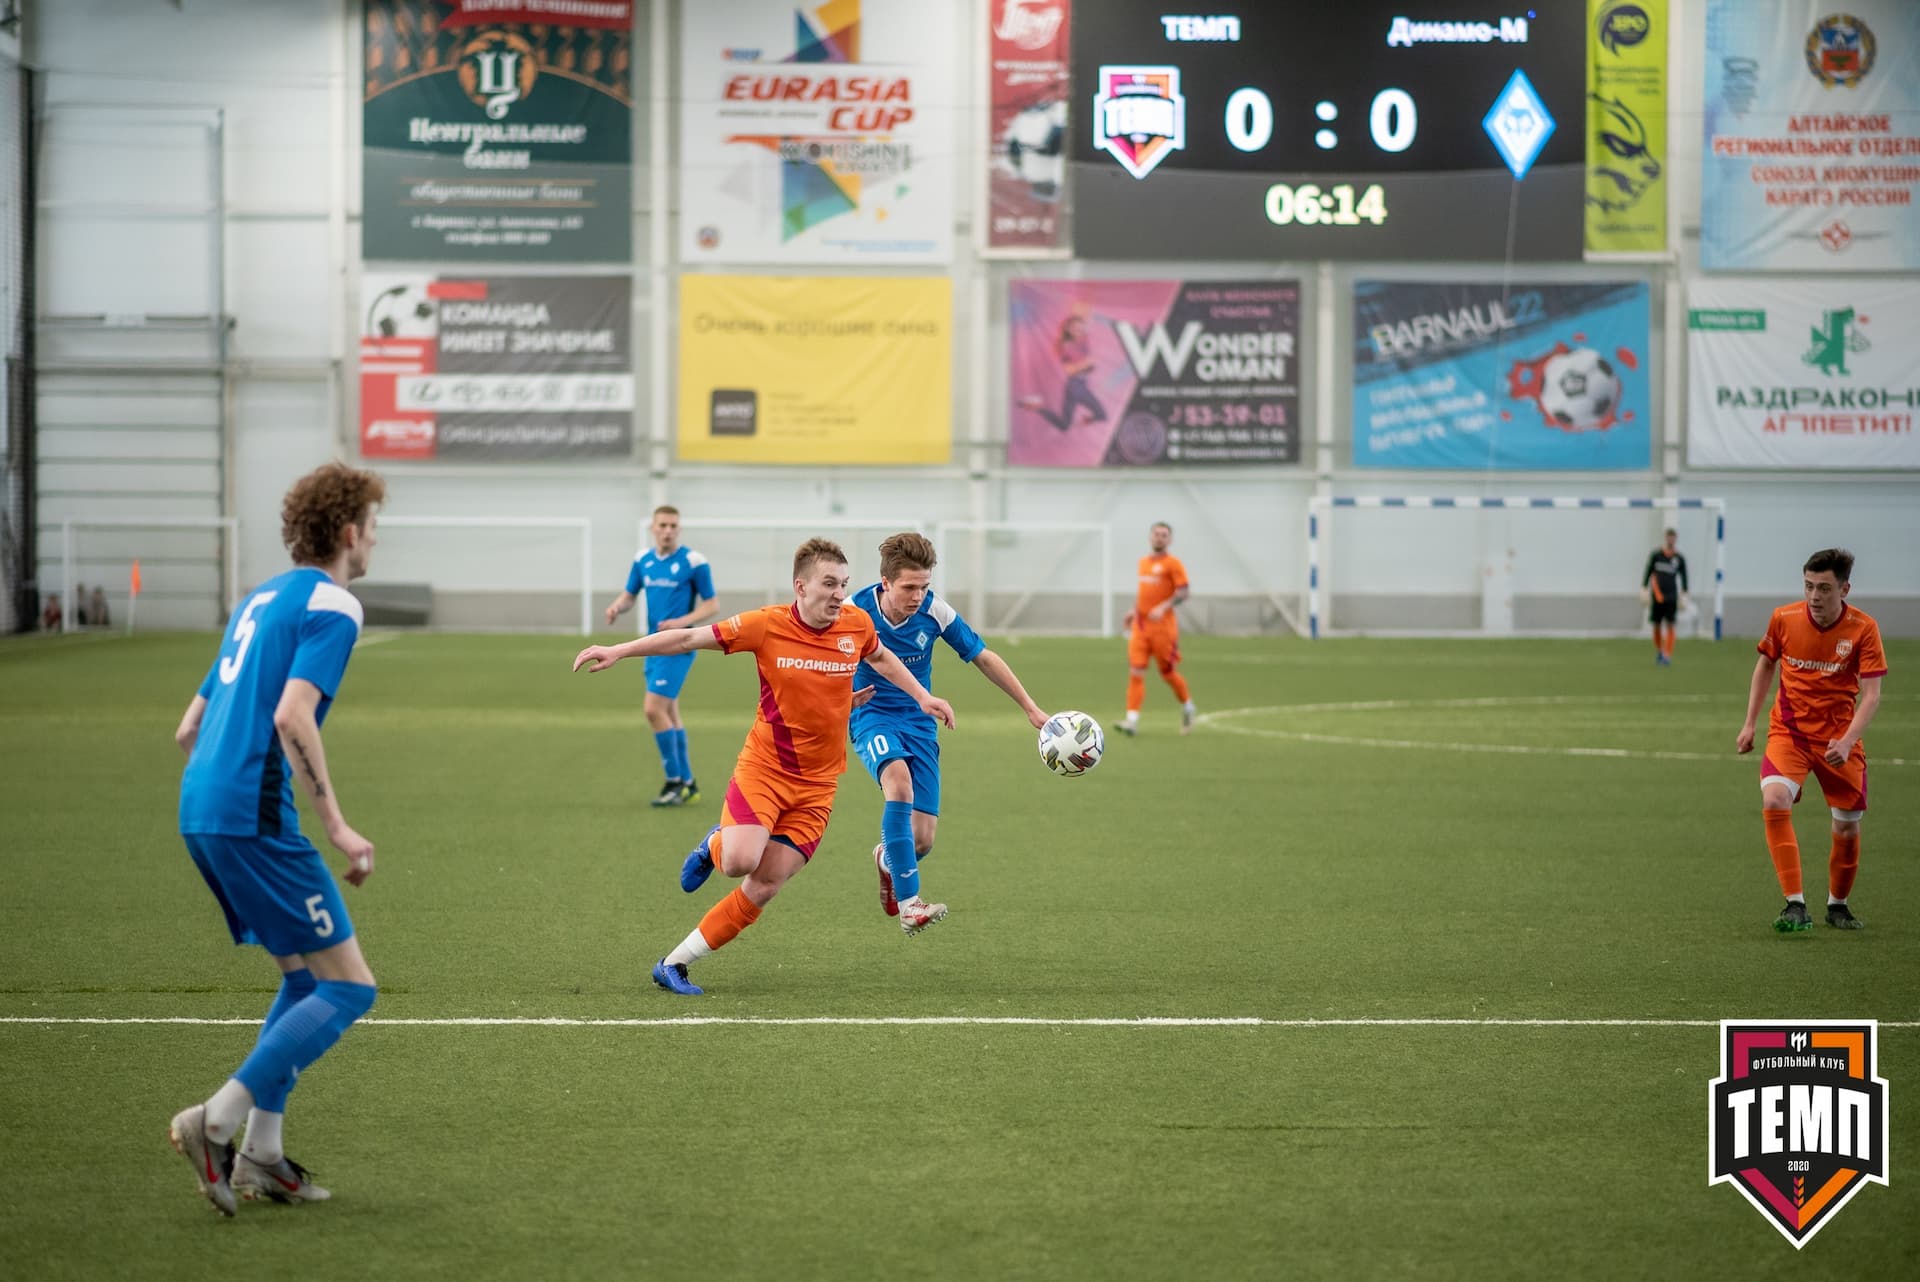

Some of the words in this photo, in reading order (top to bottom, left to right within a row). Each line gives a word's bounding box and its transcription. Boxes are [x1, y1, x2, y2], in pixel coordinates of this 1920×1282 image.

[1160, 15, 1240, 42] ТЕМП
[1386, 17, 1527, 47] Динамо-М
[724, 76, 911, 101] EURASIA
[828, 107, 915, 131] CUP
[1224, 88, 1273, 152] 0
[1369, 88, 1417, 152] 0
[1788, 112, 1891, 133] АЛТАЙСКОЕ
[409, 118, 587, 150] Центральные
[1713, 136, 1852, 156] РЕГИОНАЛЬНОЕ
[1751, 165, 1816, 184] СОЮЗА
[1264, 184, 1387, 226] 06:14
[1765, 188, 1833, 207] КАРАТЭ
[1838, 187, 1911, 206] РОССИИ
[440, 302, 550, 326] КОМАНДА
[1372, 300, 1516, 356] BARNAUL
[440, 330, 506, 352] ИМЕЕТ
[511, 330, 614, 352] ЗНАЧЕНИЕ
[1717, 386, 1920, 411] РАЗДРАКОН
[1762, 413, 1913, 434] АППЕТИТ!
[219, 590, 278, 685] 5
[867, 733, 890, 762] 10
[305, 894, 335, 938] 5
